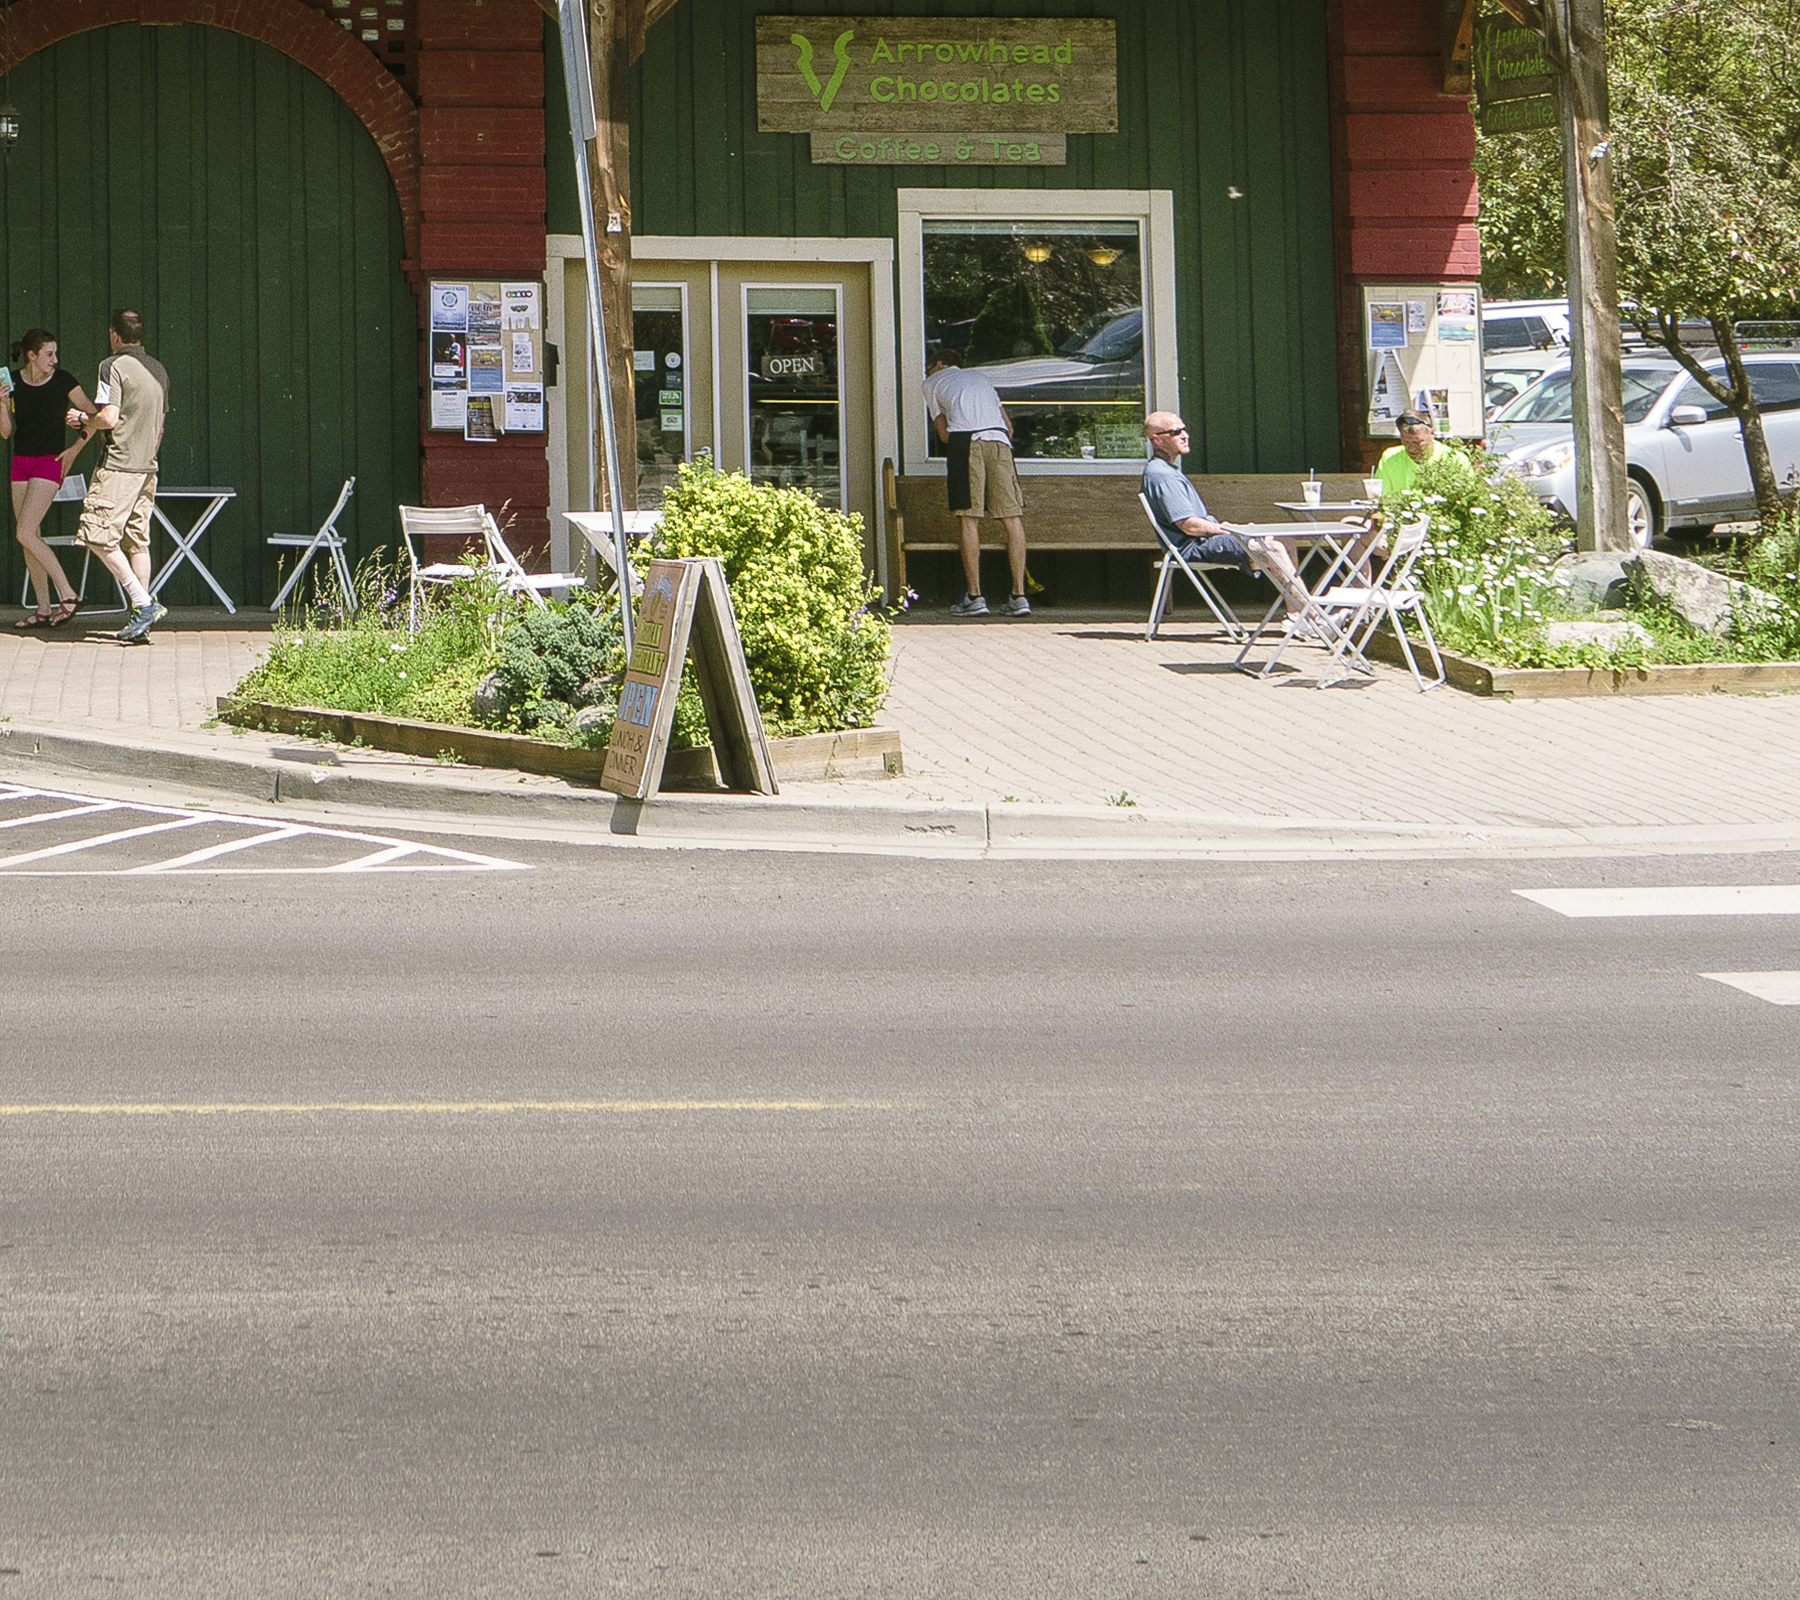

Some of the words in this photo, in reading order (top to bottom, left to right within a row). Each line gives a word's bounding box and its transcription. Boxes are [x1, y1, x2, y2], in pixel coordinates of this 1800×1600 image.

[869, 36, 1073, 64] Arrowhead
[869, 75, 1061, 103] Chocolates
[834, 137, 940, 161] Coffee
[954, 137, 974, 161] &
[986, 138, 1041, 162] Tea
[769, 357, 815, 375] OPEN
[617, 681, 659, 728] OPEN
